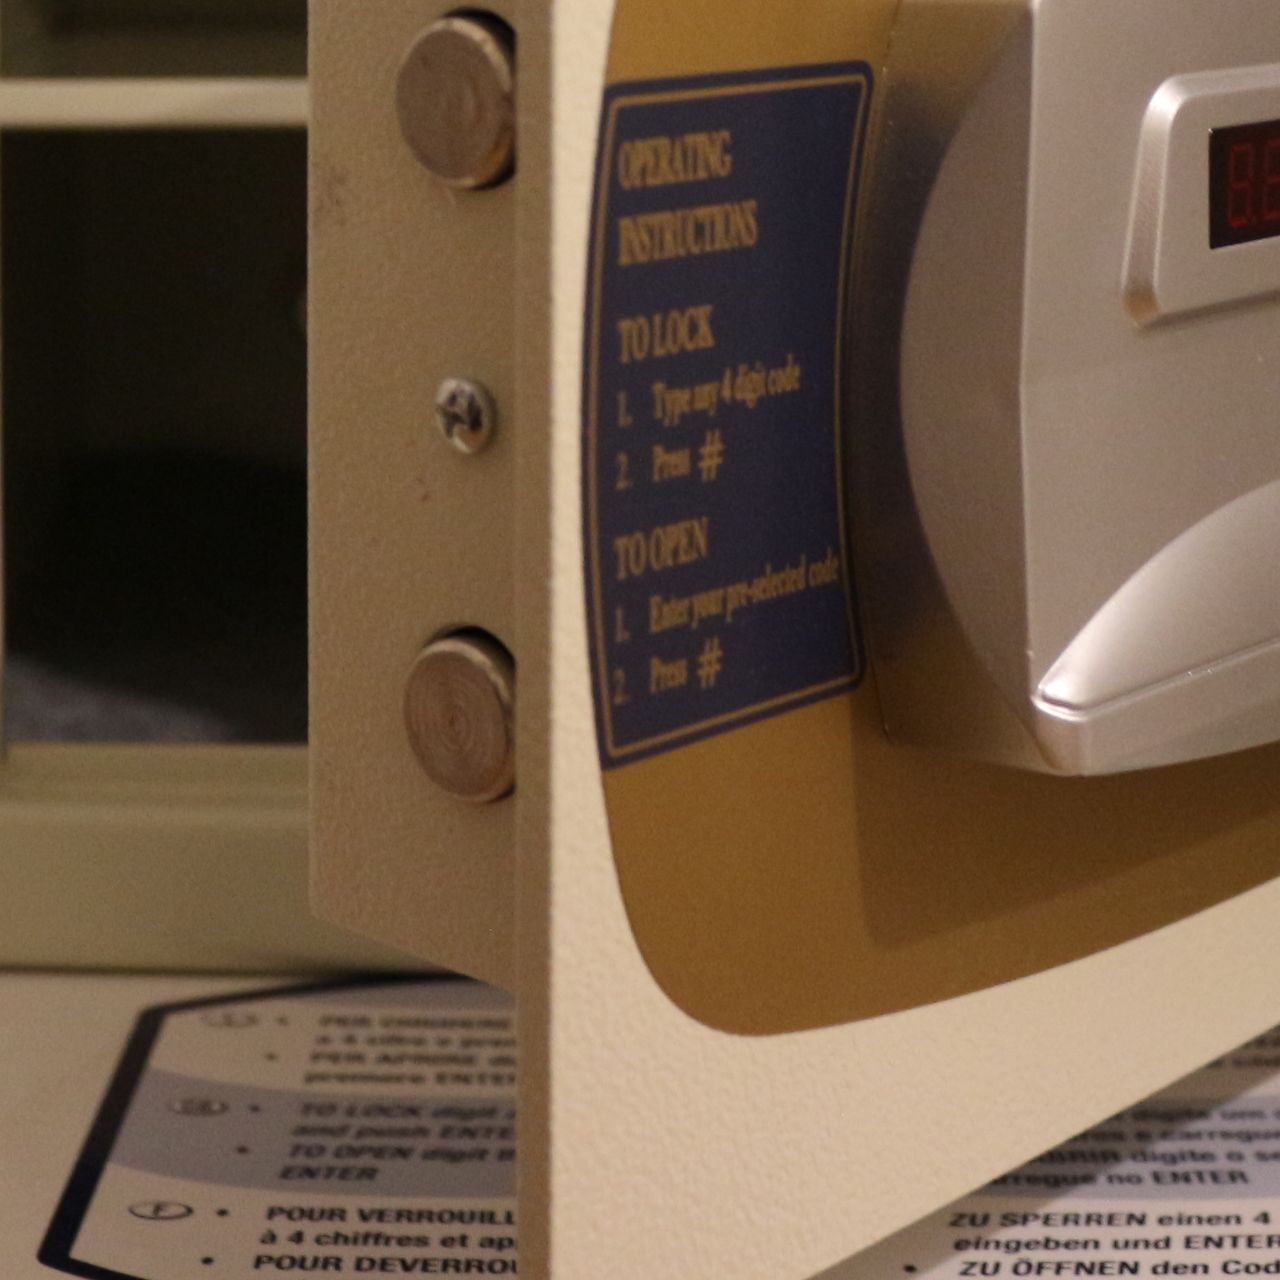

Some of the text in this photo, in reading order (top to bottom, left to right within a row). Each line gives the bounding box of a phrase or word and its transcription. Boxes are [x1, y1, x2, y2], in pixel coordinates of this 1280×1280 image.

[619, 130, 733, 190] OPERATING
[617, 199, 759, 266] INSTRUCTIONS
[617, 304, 716, 364] TO LOCK
[699, 428, 725, 482] #
[614, 516, 709, 581] TO OPEN
[808, 545, 840, 588] code
[649, 656, 688, 694] Press
[697, 634, 723, 690] #
[345, 1103, 421, 1118] LOCK
[289, 1143, 326, 1158] TO
[333, 1144, 414, 1160] OPEN
[279, 1165, 379, 1181] ENTER
[1107, 1174, 1143, 1185] no
[1151, 1171, 1249, 1185] ENTER
[266, 1205, 347, 1222] POUR
[948, 1211, 991, 1228] ZU
[999, 1210, 1148, 1228] SPERREN
[1157, 1210, 1242, 1226] einen
[1253, 1210, 1270, 1225] 4
[287, 1229, 305, 1245] 4
[314, 1230, 431, 1248] chiffres
[440, 1232, 469, 1248] et
[953, 1235, 1100, 1254] eingeben
[1112, 1235, 1172, 1250] und
[253, 1255, 343, 1272] POUR
[958, 1260, 1002, 1277] ZU
[1011, 1256, 1140, 1277] ÖFFNEN
[1151, 1260, 1210, 1276] den
